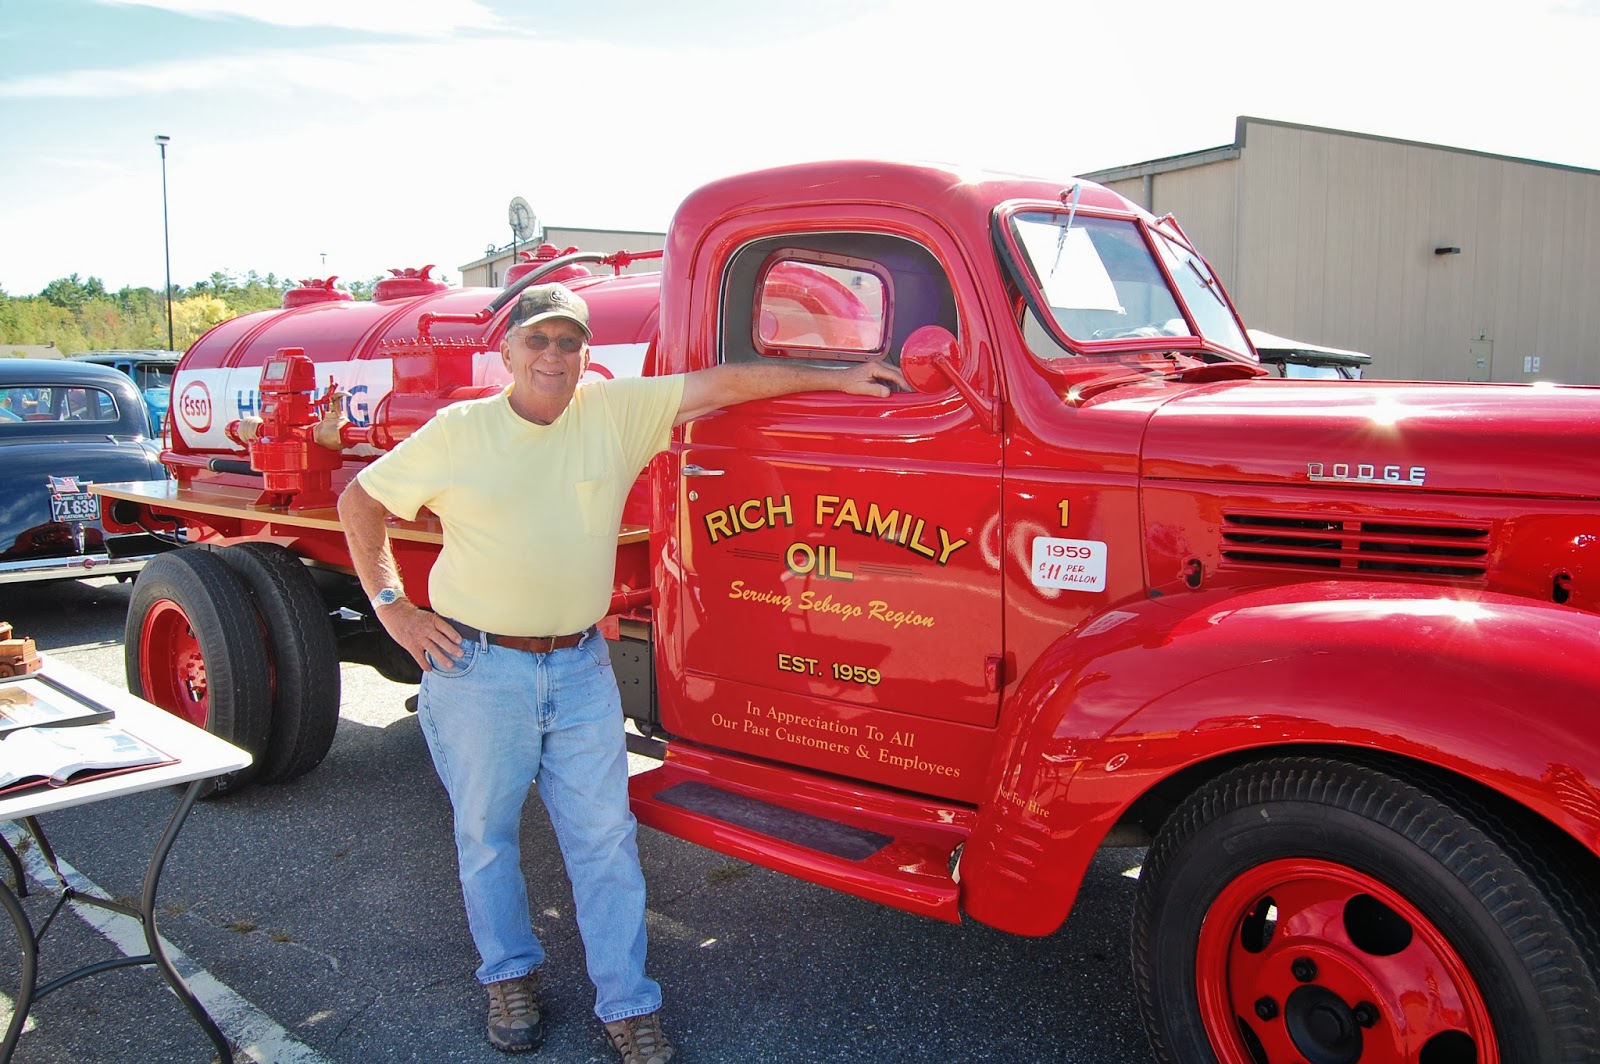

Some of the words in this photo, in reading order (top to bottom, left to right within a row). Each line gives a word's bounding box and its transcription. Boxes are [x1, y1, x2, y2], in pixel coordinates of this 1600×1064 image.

[1307, 463, 1426, 483] DODGE
[1057, 499, 1069, 528] 1
[704, 494, 794, 545] RICH
[814, 494, 970, 568] FAMILY
[785, 542, 854, 582] OIL
[1046, 545, 1091, 559] 1959
[1062, 574, 1097, 584] GALLON
[1066, 564, 1085, 573] PER
[728, 581, 793, 612] Serving
[798, 591, 863, 621] Sebago
[868, 600, 935, 629] Region
[777, 653, 823, 677] EST.
[832, 662, 882, 687] 1959
[746, 701, 761, 716] In
[766, 705, 859, 737] Appreciation
[865, 725, 884, 742] To
[890, 731, 915, 748] All
[711, 713, 738, 730] Our
[743, 719, 770, 737] Past
[775, 728, 850, 755] Customers
[856, 744, 871, 759] &
[878, 749, 961, 778] Employees
[1012, 792, 1025, 807] For
[1028, 799, 1050, 818] Hire
